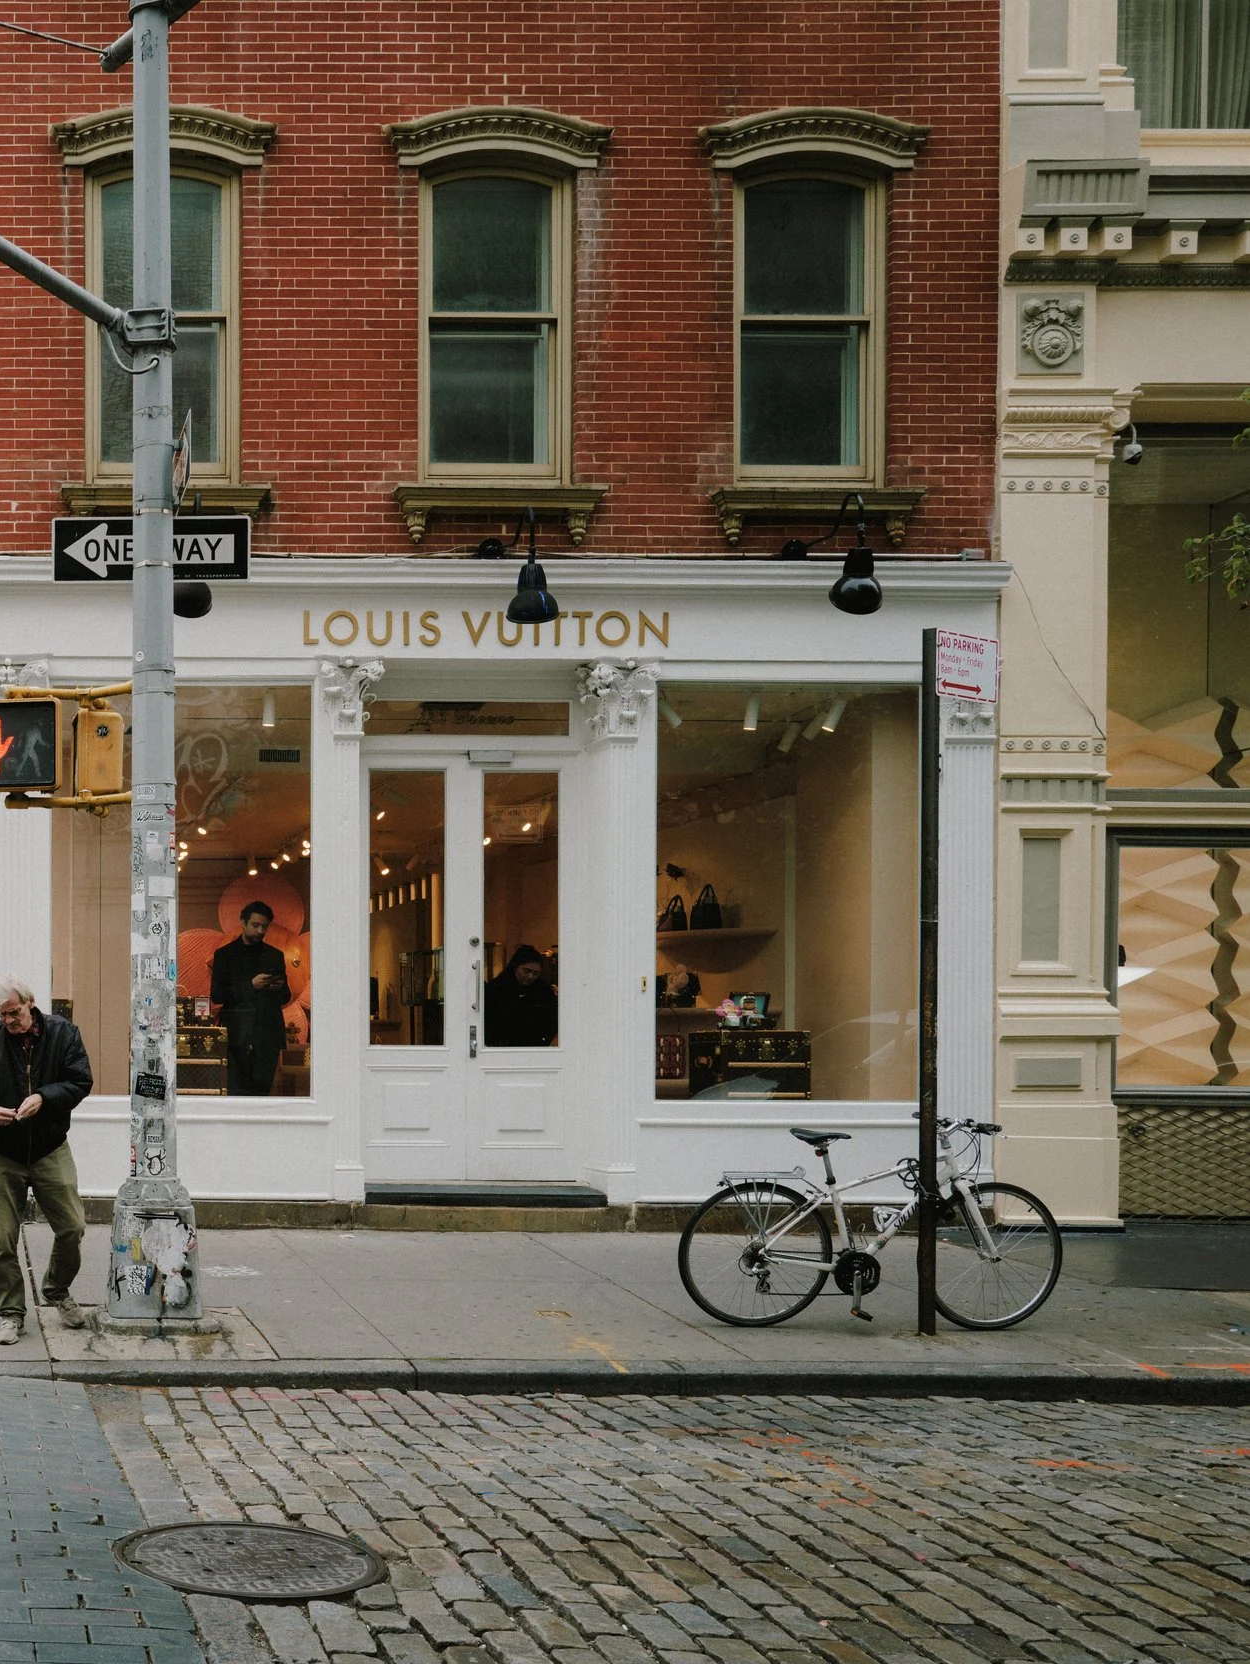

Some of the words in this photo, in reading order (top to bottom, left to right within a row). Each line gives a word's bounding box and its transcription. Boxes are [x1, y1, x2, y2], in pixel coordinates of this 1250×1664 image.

[84, 538, 133, 562] ONE
[303, 610, 441, 646] LOUIS
[462, 610, 669, 648] VUITTON
[941, 636, 951, 649] NO
[953, 638, 984, 655] PARKING
[941, 652, 962, 665] Monday
[966, 656, 983, 670] Friday
[894, 1201, 920, 1229] SPECIA
